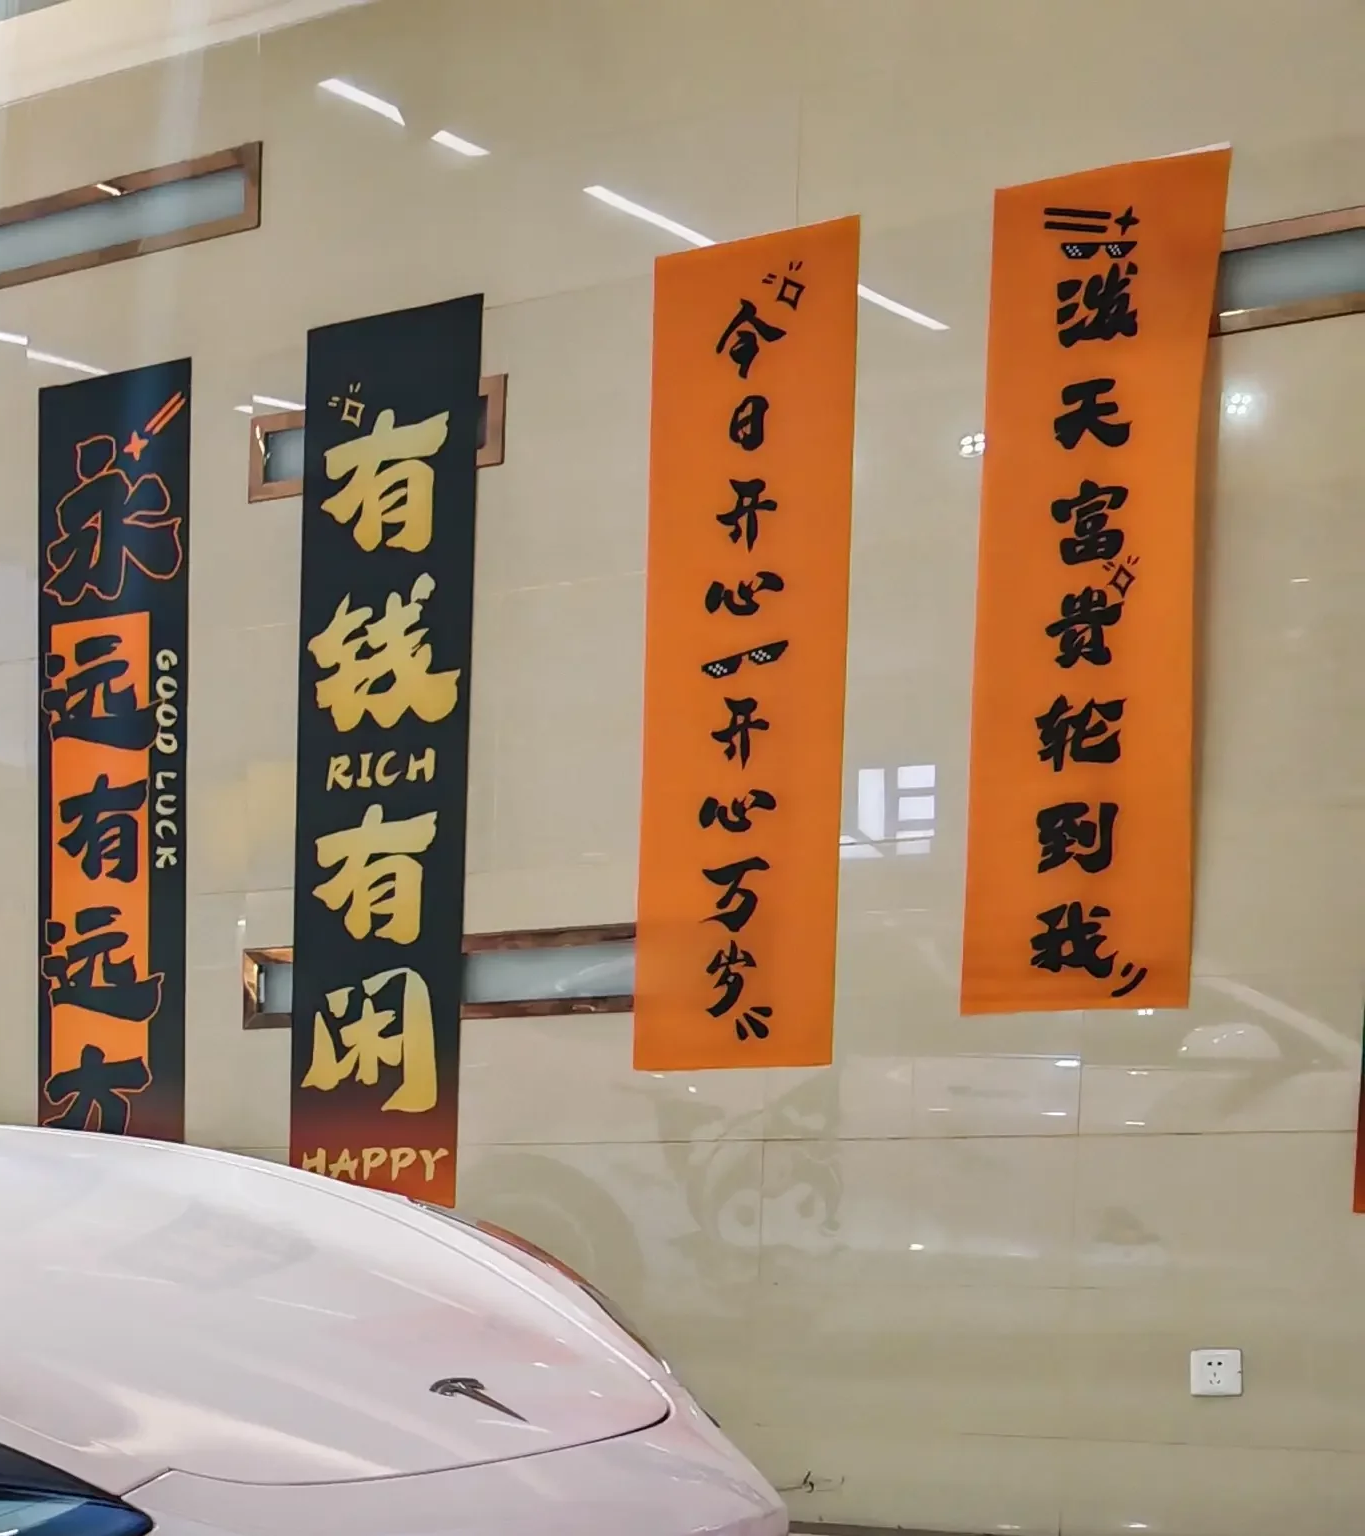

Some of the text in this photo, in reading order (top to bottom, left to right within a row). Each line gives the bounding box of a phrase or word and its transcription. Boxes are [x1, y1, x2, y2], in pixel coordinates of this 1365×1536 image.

[311, 408, 460, 731] 有钱
[154, 648, 180, 870] GOOD LUCK
[326, 748, 437, 793] RICH
[302, 1147, 449, 1182] HAPPY
